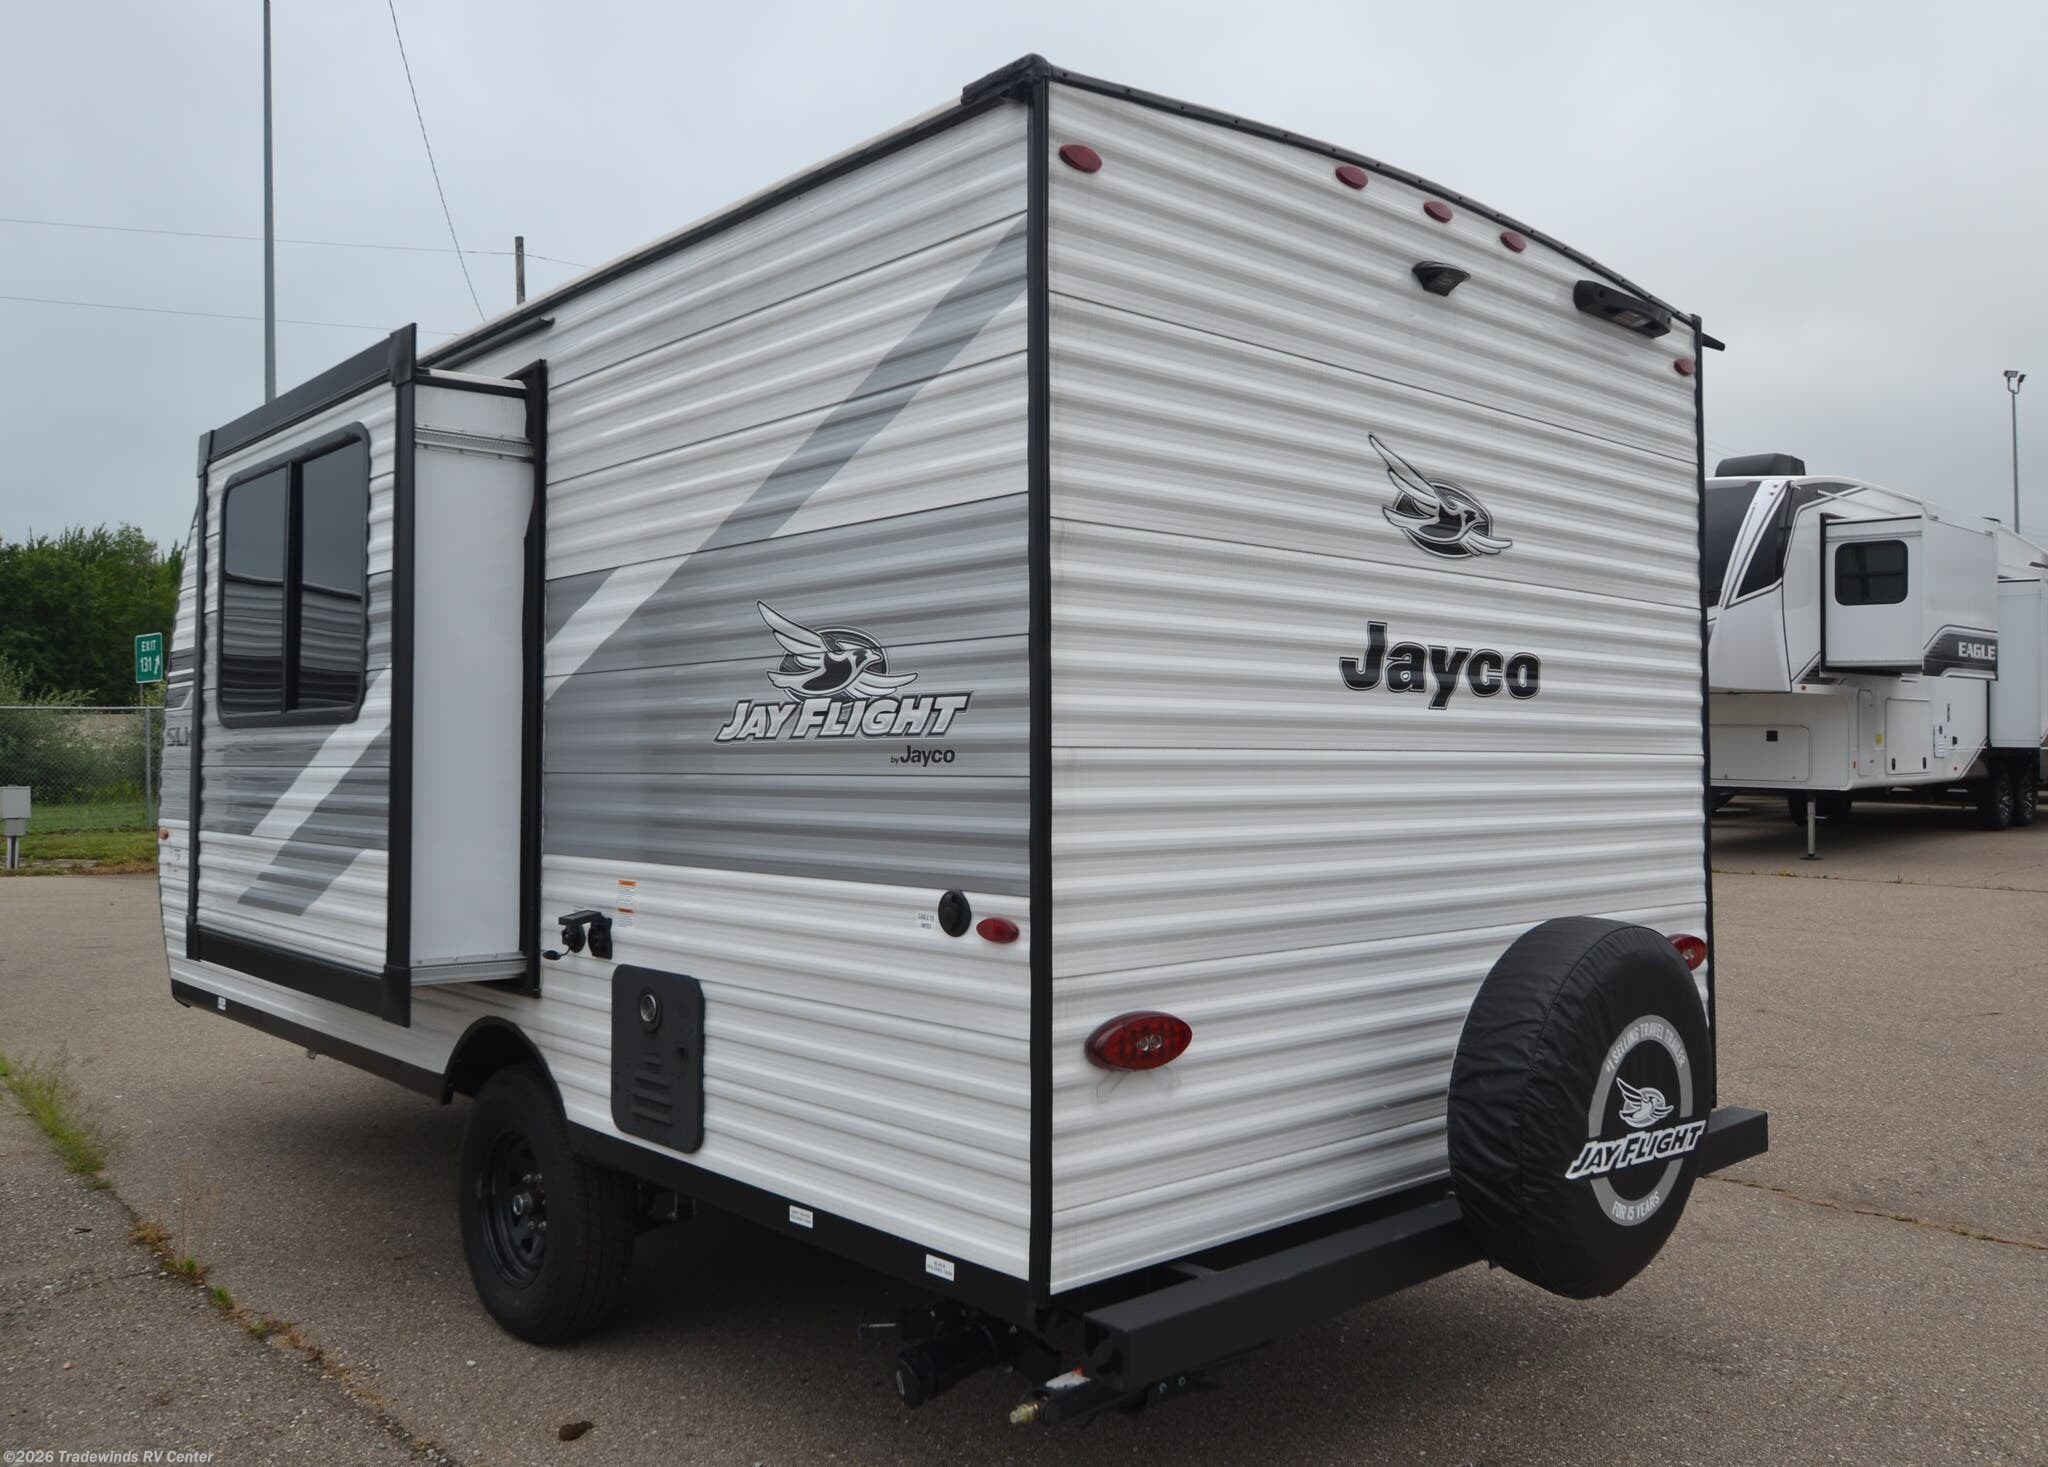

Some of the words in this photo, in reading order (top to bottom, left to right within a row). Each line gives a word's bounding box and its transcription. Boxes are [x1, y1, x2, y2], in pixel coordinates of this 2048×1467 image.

[141, 640, 156, 652] EXIT
[1958, 641, 1996, 660] EAGLE
[1339, 621, 1541, 710] Jayco
[714, 699, 797, 743] JAY
[789, 690, 974, 741] FLIGHT
[890, 755, 899, 765] by
[900, 745, 955, 767] Jayco
[1612, 1026, 1639, 1064] SELLING
[1640, 1022, 1664, 1040] TRAVEL
[1565, 1140, 1623, 1179] JAY
[1615, 1119, 1706, 1170] FLIGHT
[1612, 1201, 1626, 1220] FOR
[1626, 1205, 1635, 1220] 15
[1635, 1190, 1660, 1219] YEARS
